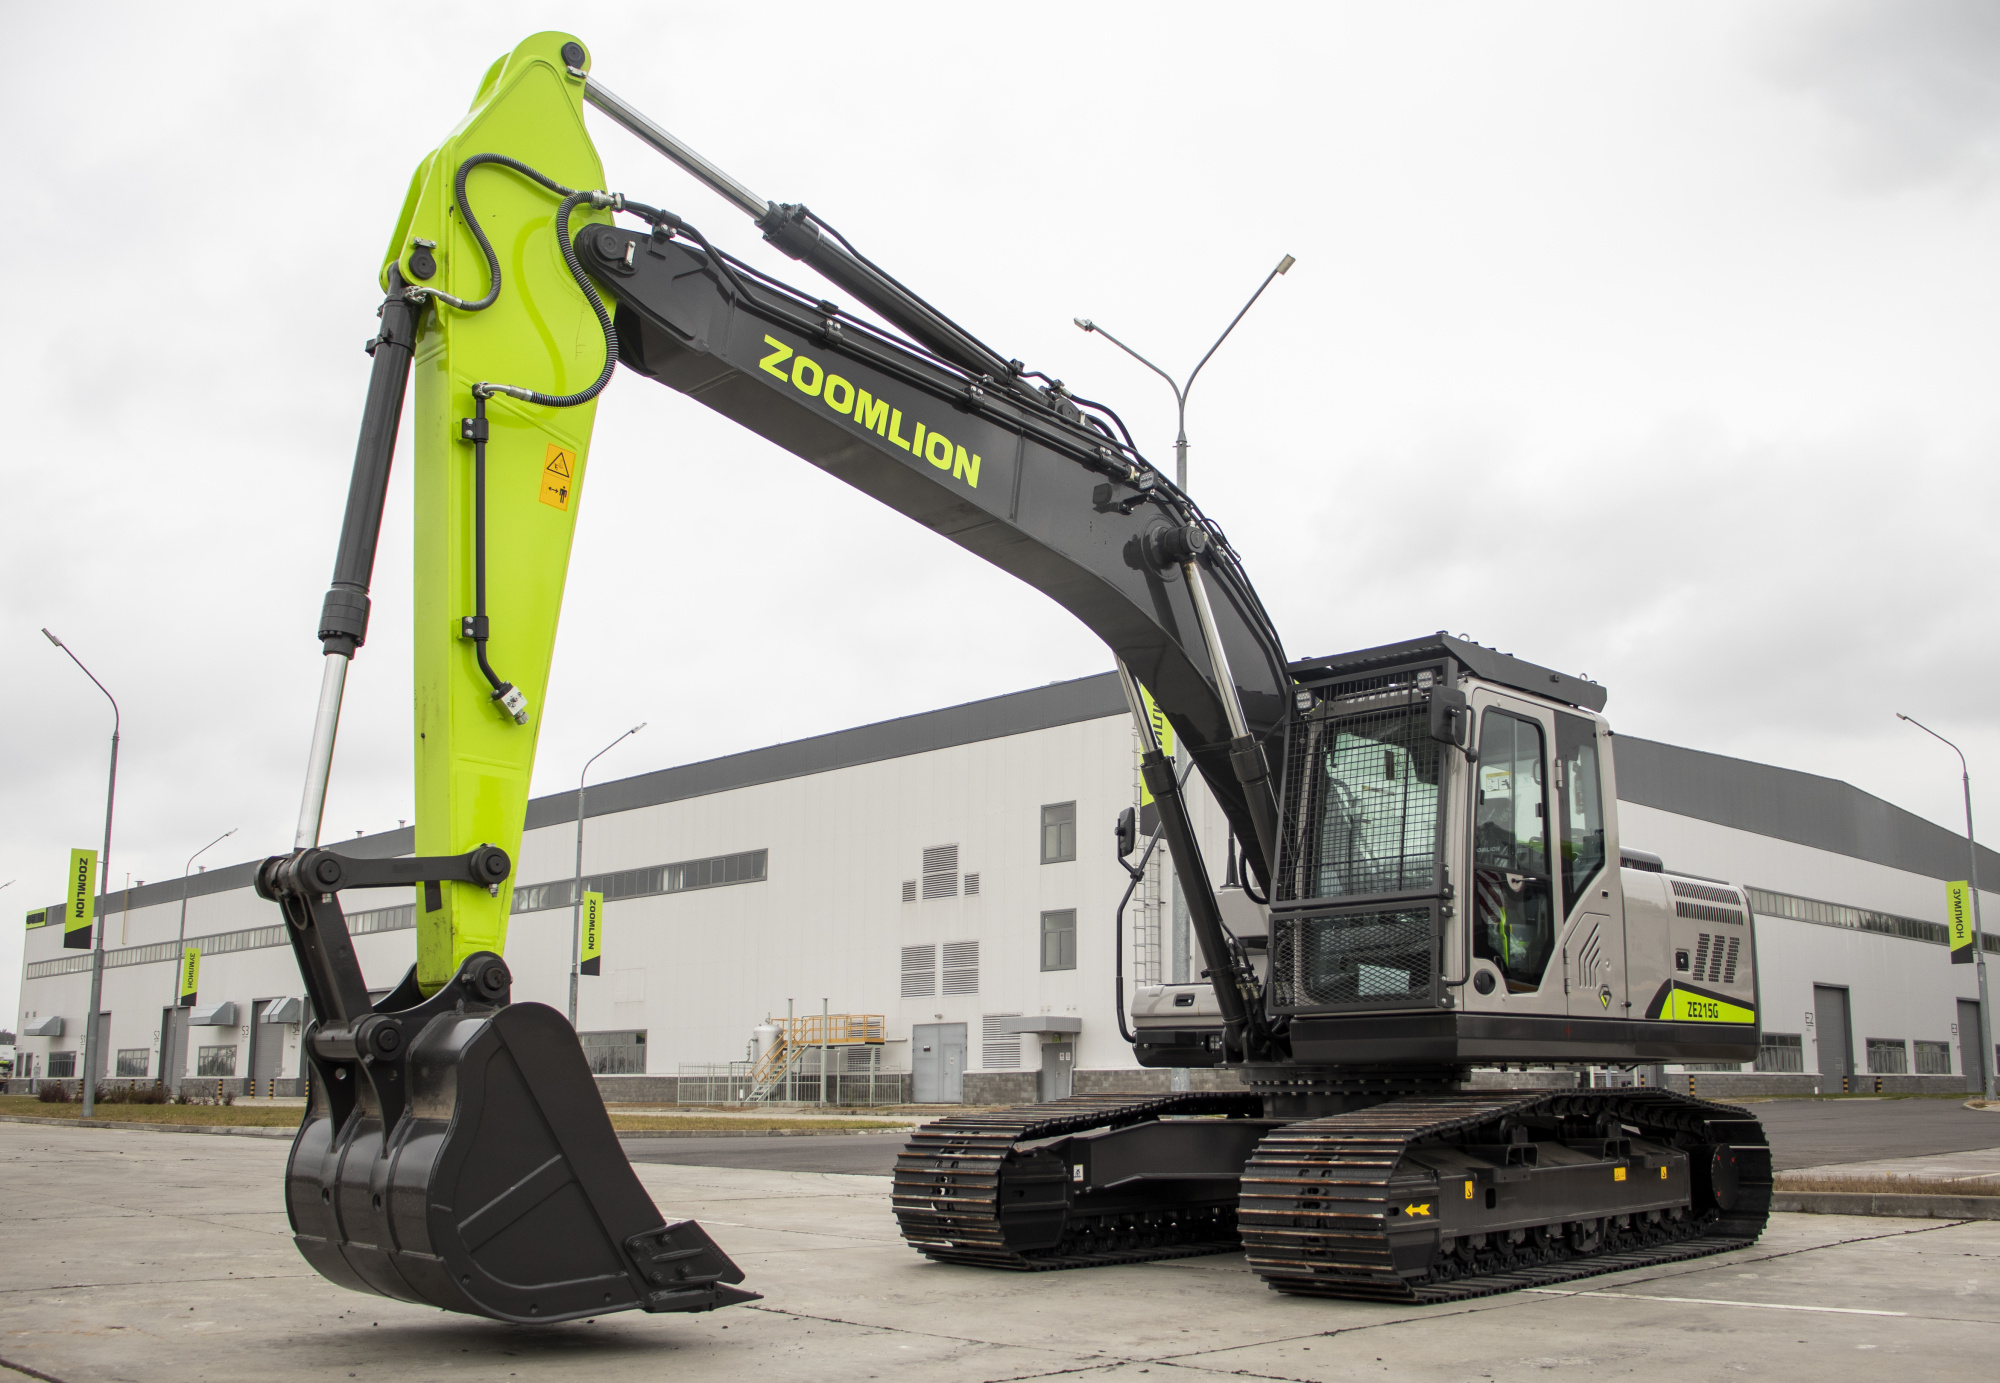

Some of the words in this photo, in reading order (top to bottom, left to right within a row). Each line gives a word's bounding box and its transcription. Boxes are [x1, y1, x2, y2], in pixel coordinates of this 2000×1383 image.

[759, 334, 981, 489] ZOOMLION
[75, 857, 88, 918] ZOOMLION
[588, 899, 596, 950] ZOOMLION
[1953, 888, 1964, 938] ЗУМЛИОН
[187, 953, 195, 988] ЗУМЛИОН
[1687, 1001, 1719, 1018] ZE215G
